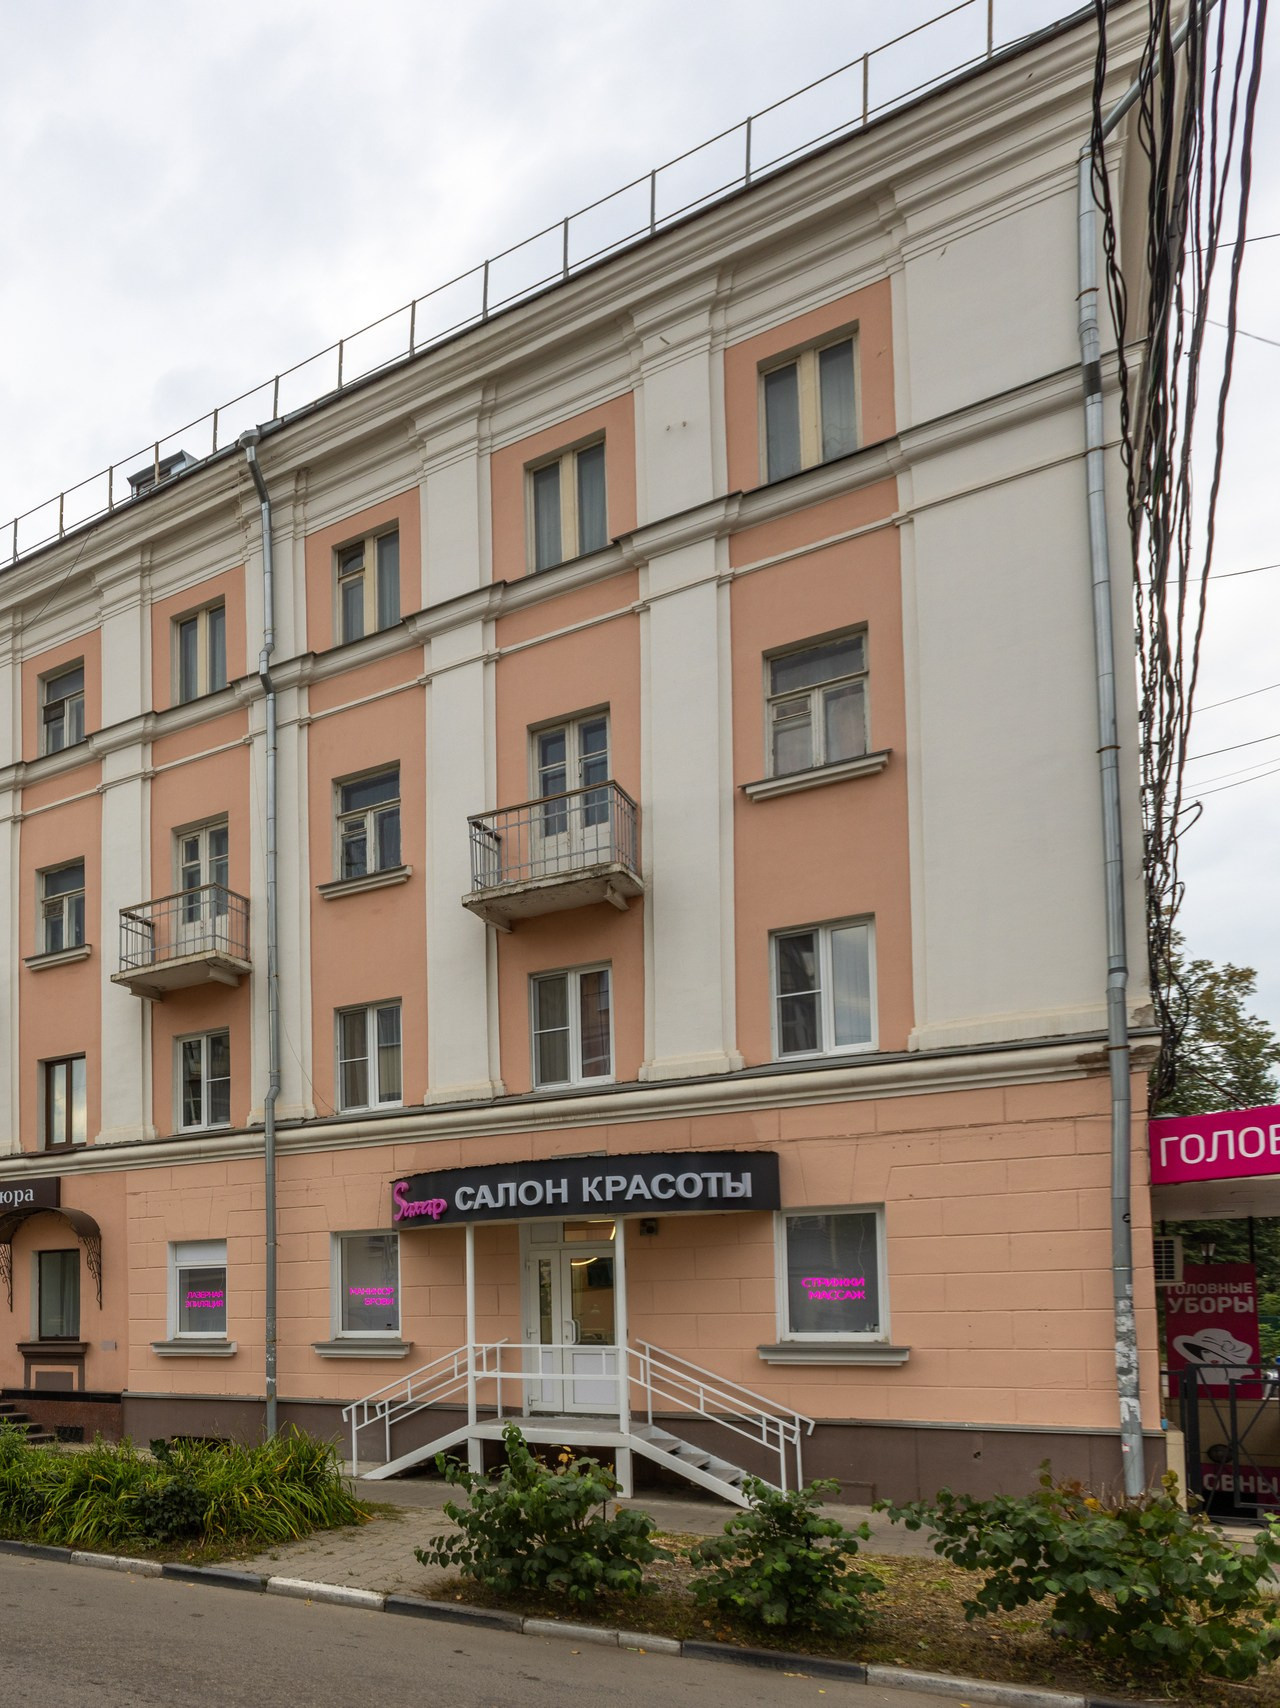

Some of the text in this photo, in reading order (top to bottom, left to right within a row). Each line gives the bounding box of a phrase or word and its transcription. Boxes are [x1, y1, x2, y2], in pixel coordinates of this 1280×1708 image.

[454, 1178, 568, 1211] САЛОН
[581, 1172, 752, 1203] КРАСОТЫ
[801, 1277, 865, 1288] СТРИЖКИ
[349, 1287, 395, 1297] МАНИКЮР
[1167, 1282, 1254, 1295] ГОЛОВНЫЕ
[186, 1291, 224, 1299] ЛАЗЕРНАЯ
[808, 1290, 866, 1301] МАССАЖ
[185, 1300, 224, 1309] ЭПИЛЯЦИЯ
[364, 1297, 394, 1306] БРОВИ
[1167, 1295, 1255, 1314] УБОРЫ
